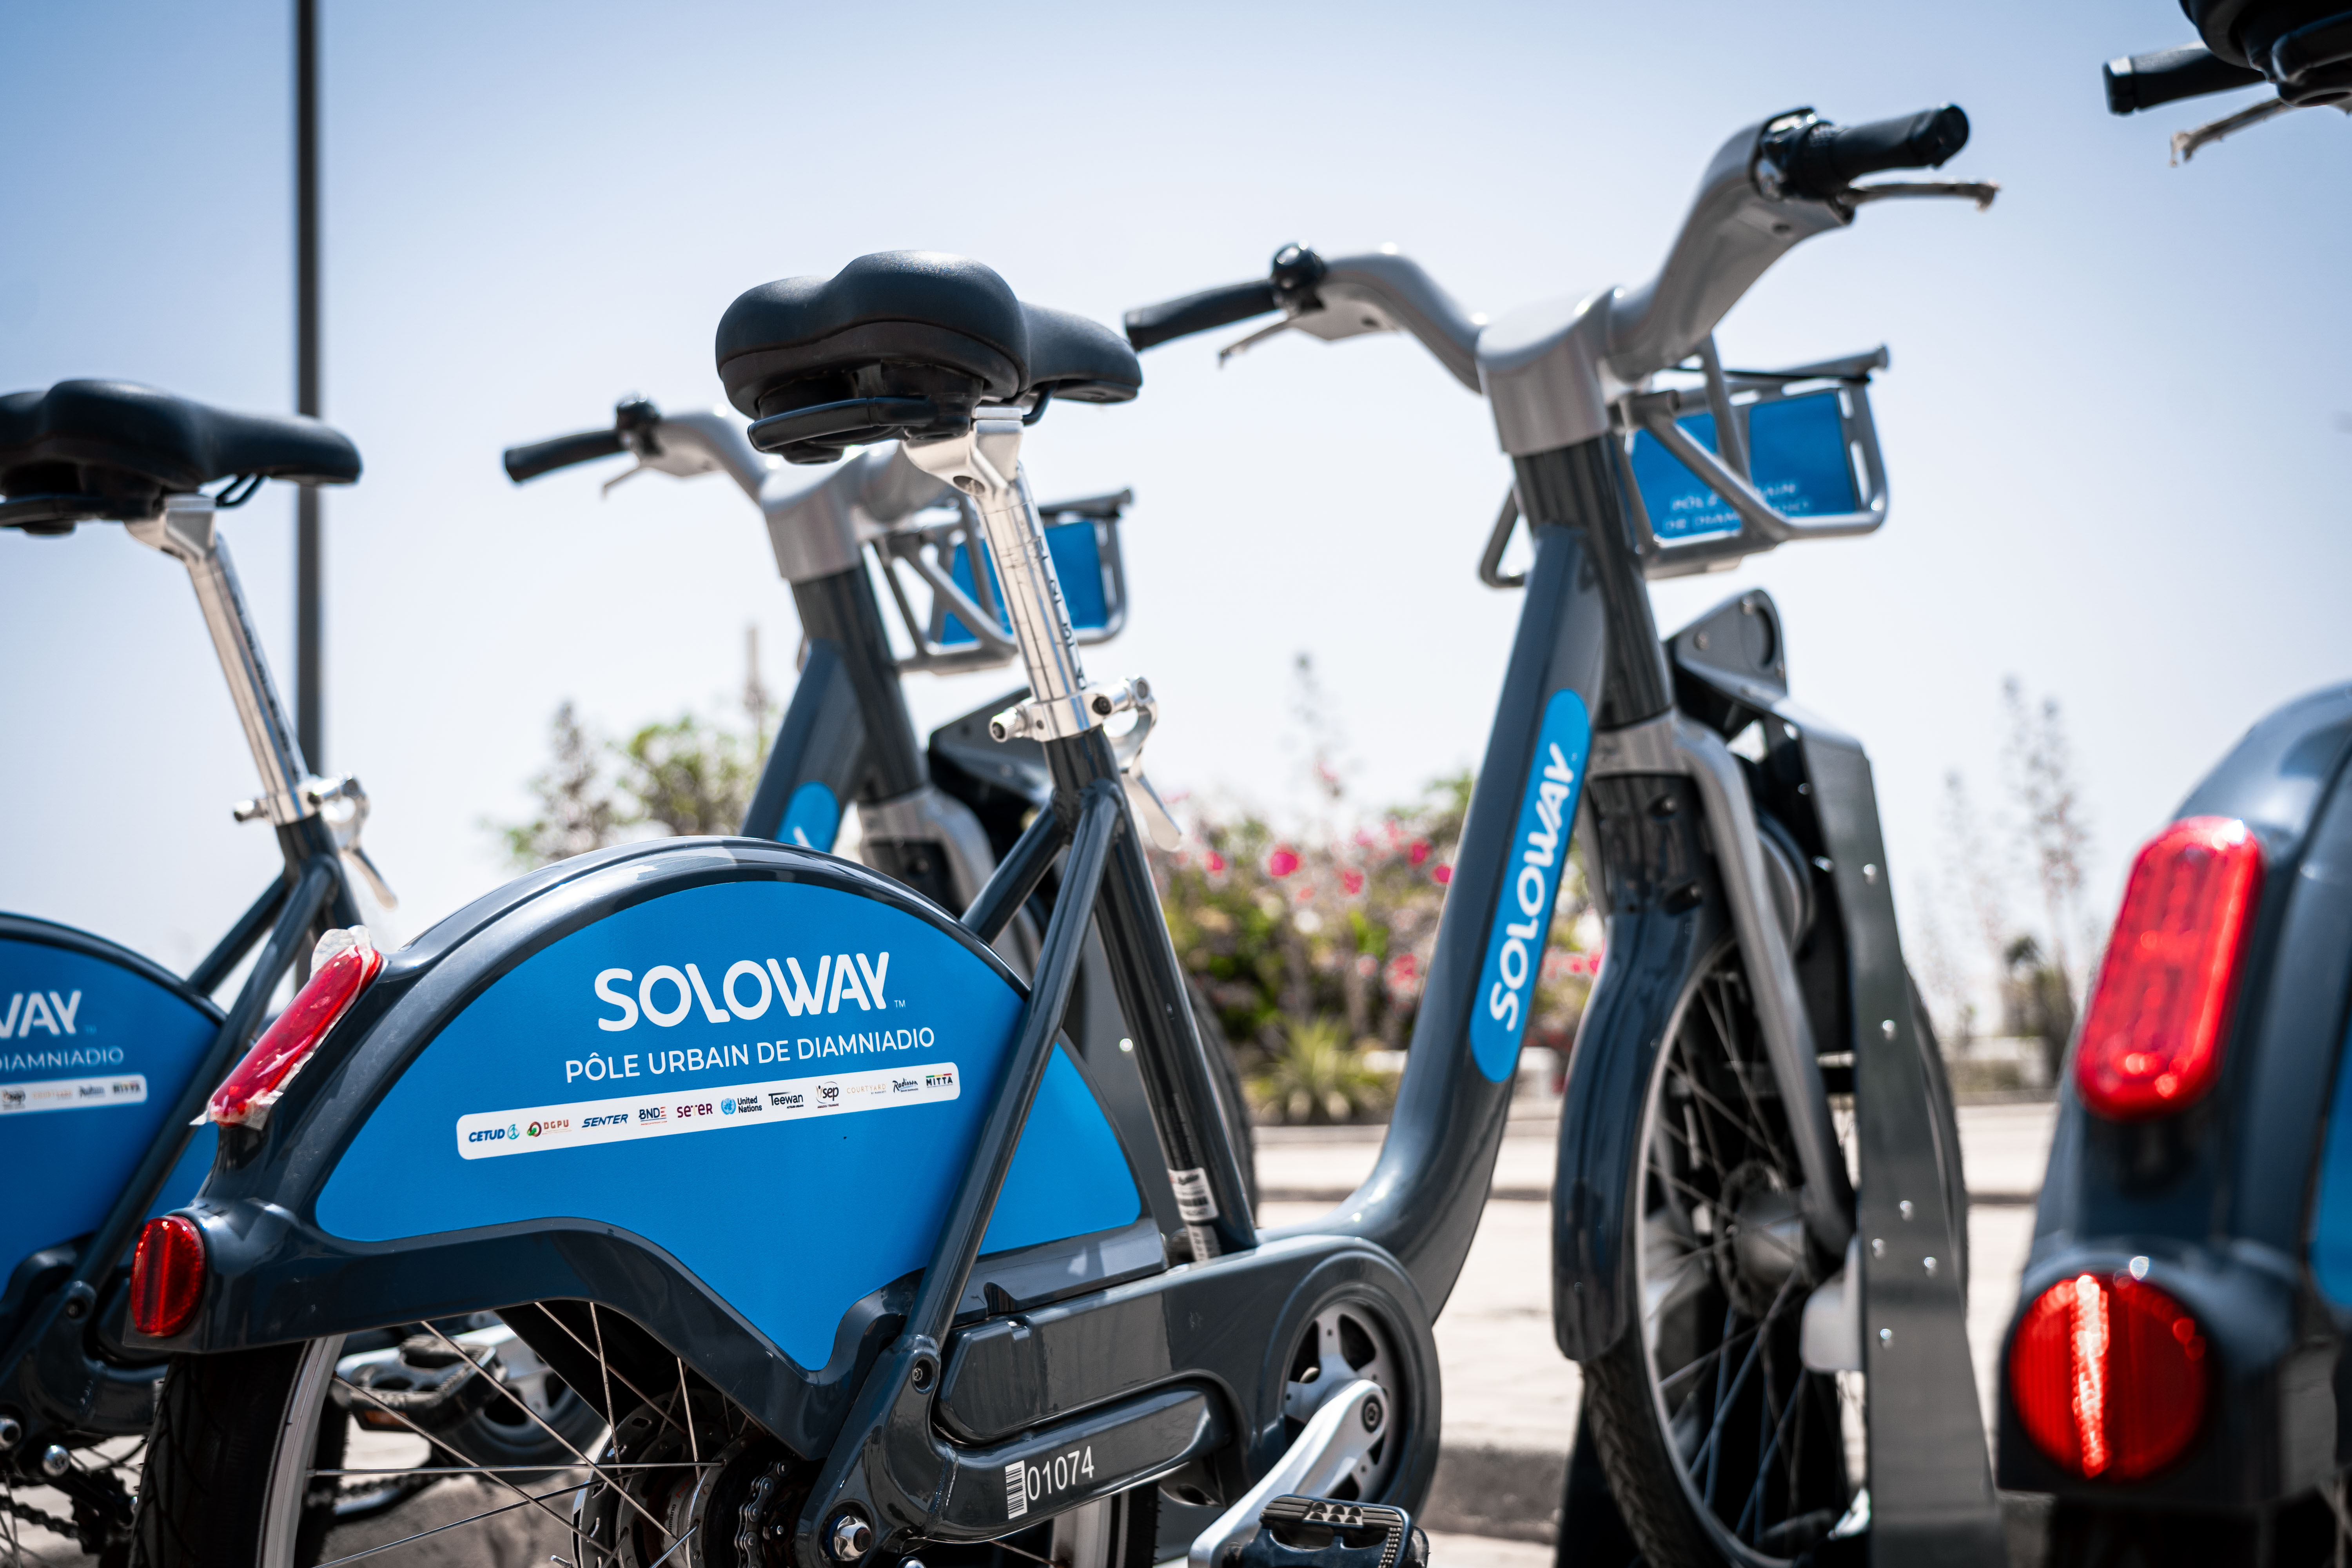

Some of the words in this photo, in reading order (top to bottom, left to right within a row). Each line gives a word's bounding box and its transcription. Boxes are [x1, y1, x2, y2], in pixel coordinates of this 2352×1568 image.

[1490, 741, 1574, 1031] SOLOWAY
[594, 952, 889, 1032] SOLOWAY
[894, 999, 906, 1008] TM
[0, 1047, 124, 1071] IAMNIADIO
[566, 1052, 640, 1083] PÔLE
[648, 1044, 749, 1074] URBAIN
[757, 1040, 791, 1063] DE
[797, 1027, 935, 1060] DIAMNIADIO
[846, 1083, 886, 1094] COURTYARD
[892, 1078, 918, 1093] Radisson
[926, 1076, 953, 1087] MITTA
[737, 1096, 758, 1105] United
[768, 1092, 804, 1106] Teewan
[639, 1106, 666, 1120] BNDE
[738, 1104, 762, 1114] Nations
[544, 1119, 569, 1129] DGPU
[581, 1114, 628, 1128] SENTER
[468, 1129, 505, 1142] CETUD
[1027, 1446, 1094, 1501] 01074
[668, 1504, 677, 1534] HIMANO
